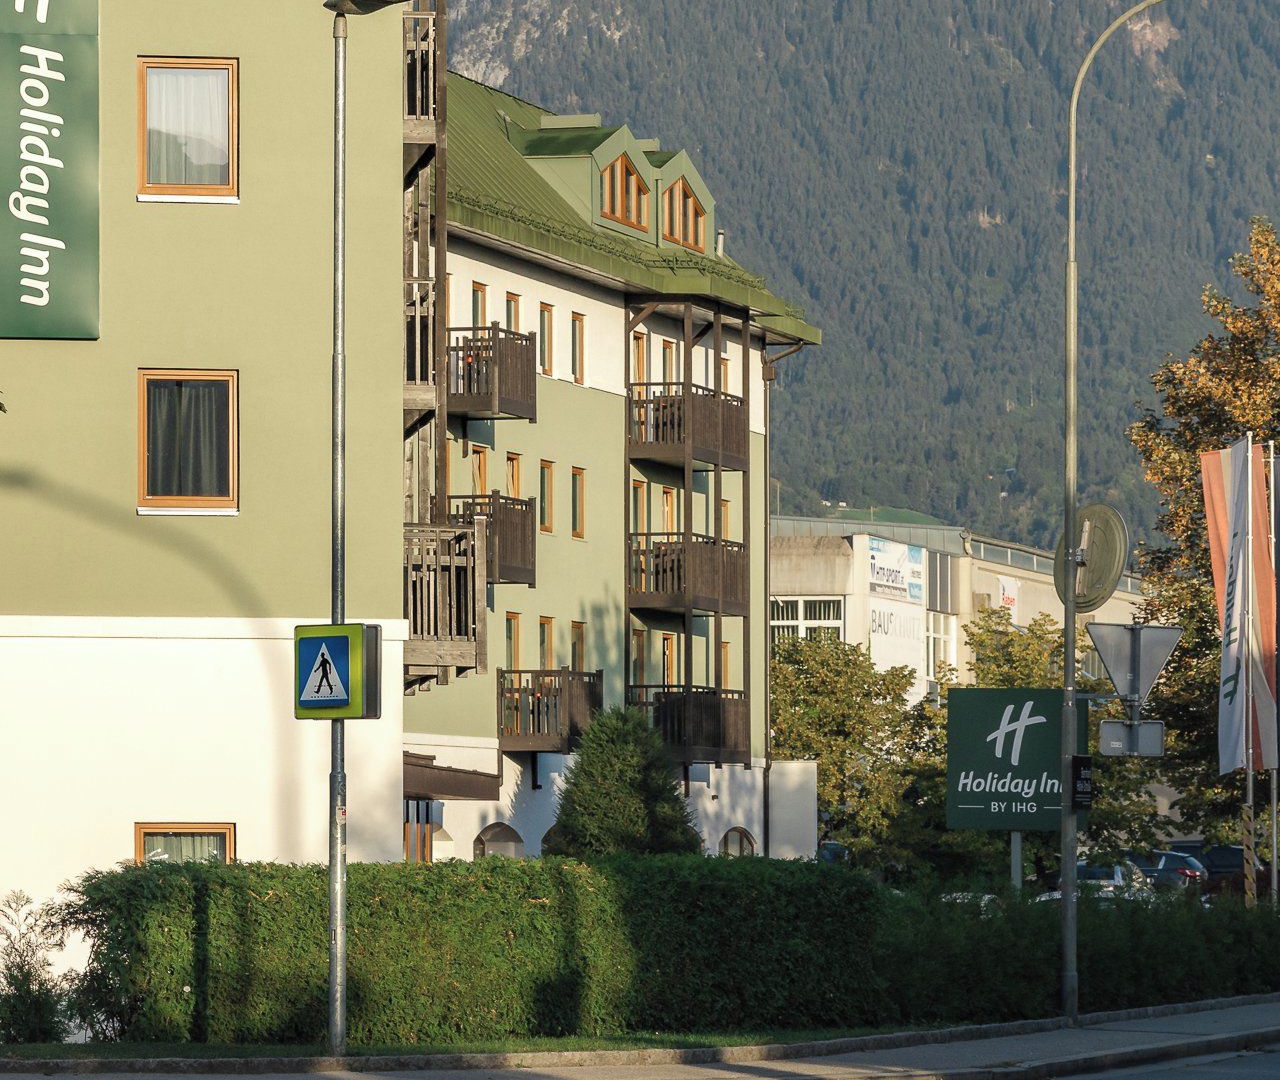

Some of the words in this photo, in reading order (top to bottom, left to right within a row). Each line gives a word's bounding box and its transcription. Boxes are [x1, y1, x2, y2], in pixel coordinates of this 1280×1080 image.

[8, 44, 66, 226] Holiday
[19, 233, 66, 307] Inn
[957, 771, 1037, 798] Holiday
[990, 801, 1007, 813] BY
[1012, 801, 1037, 813] IHG
